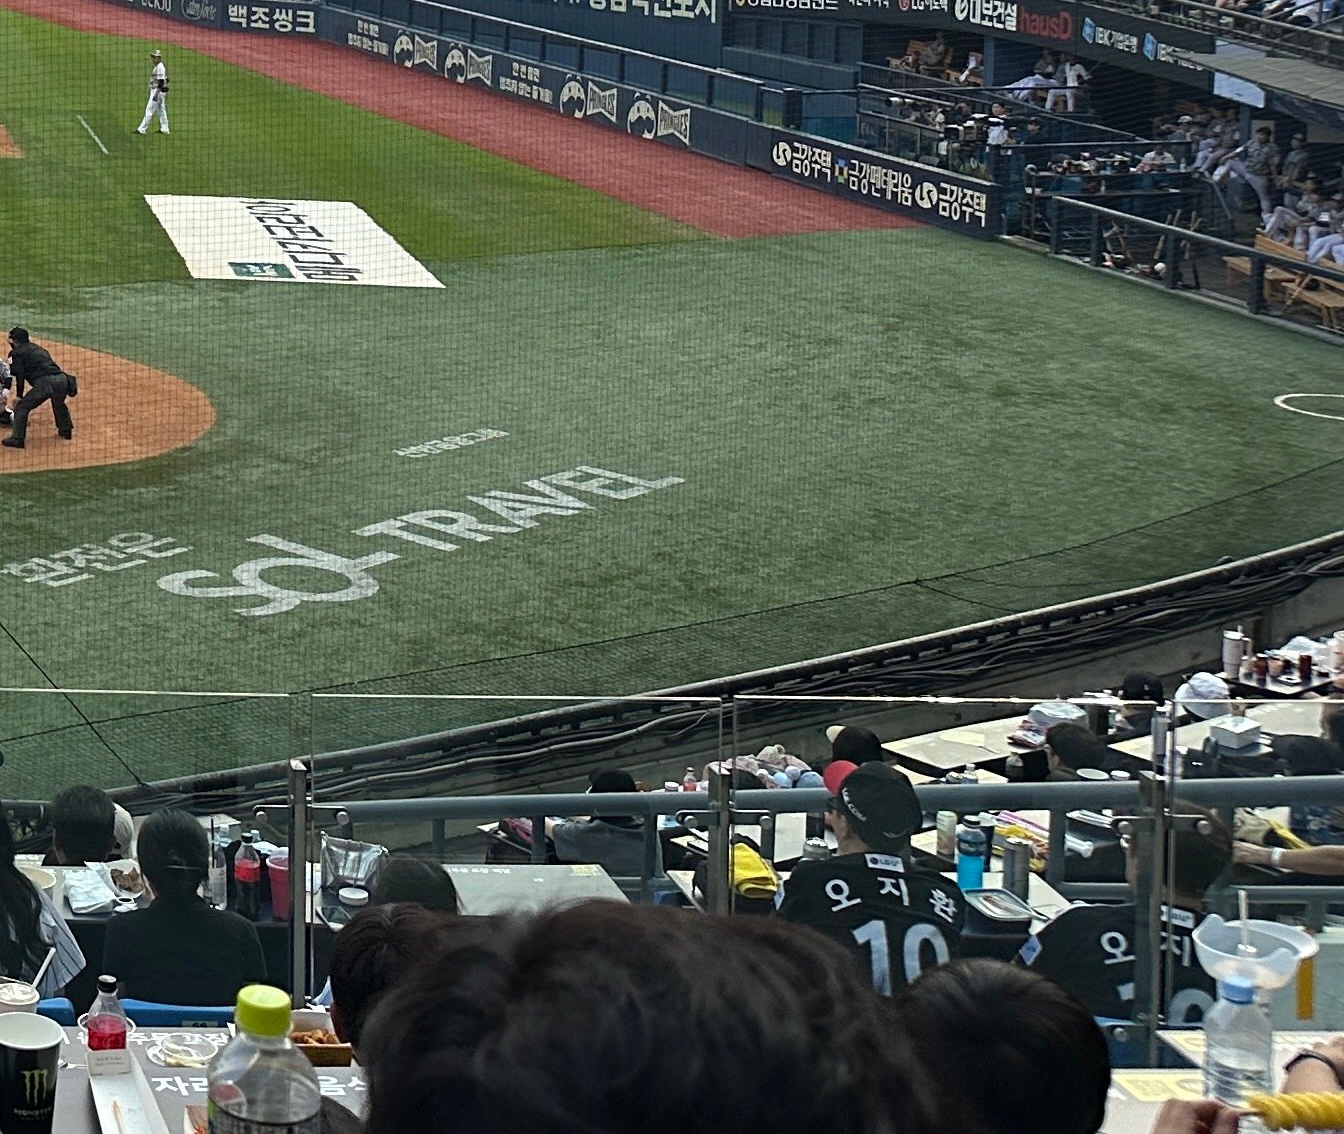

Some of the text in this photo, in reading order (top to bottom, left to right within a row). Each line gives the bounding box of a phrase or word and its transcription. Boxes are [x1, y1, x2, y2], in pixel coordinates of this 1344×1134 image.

[228, 4, 316, 34] 백조씽크
[792, 142, 832, 183] 금강주택
[939, 182, 987, 228] 금강주택
[239, 200, 363, 282] 메디카코리아
[351, 465, 686, 552] TRAVEL
[851, 920, 950, 997] 10
